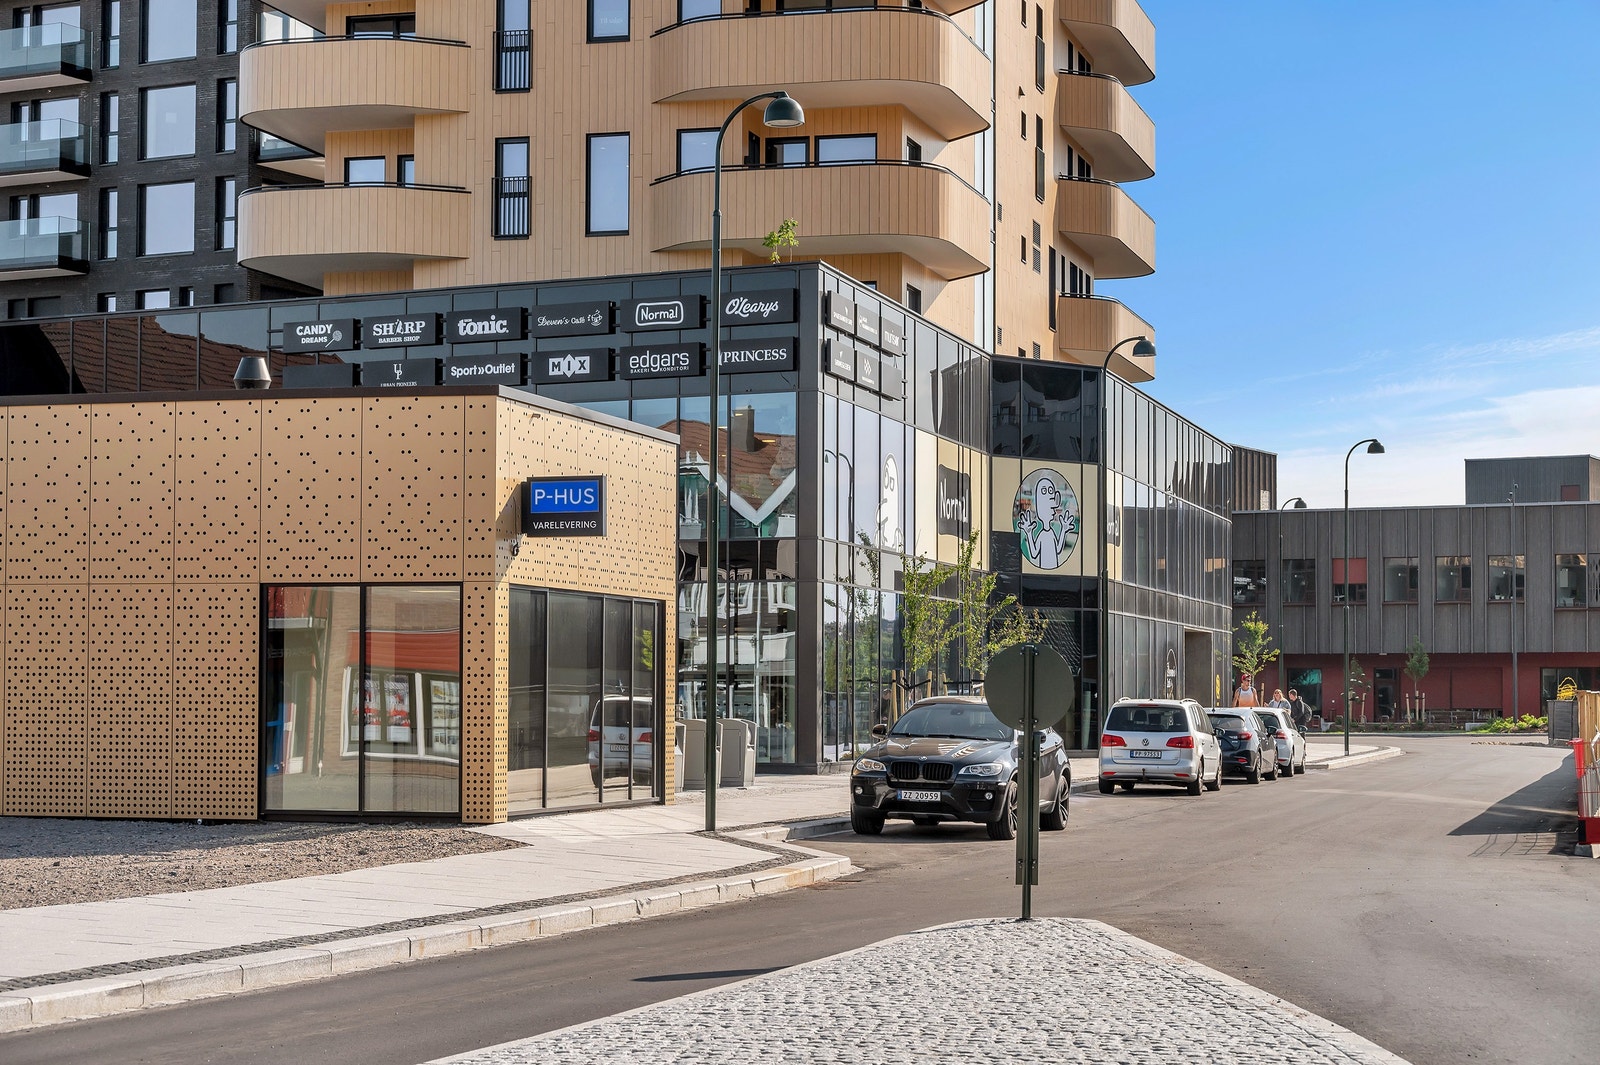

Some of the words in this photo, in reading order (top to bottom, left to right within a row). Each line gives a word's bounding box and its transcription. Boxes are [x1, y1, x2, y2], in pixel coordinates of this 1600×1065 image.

[640, 306, 679, 323] Normal
[725, 296, 779, 318] O'Learys
[296, 323, 333, 336] CANDY
[372, 318, 426, 337] SHARP
[301, 335, 328, 344] DREAMS
[378, 336, 402, 344] BARBER
[403, 335, 421, 343] SHOP
[629, 350, 690, 373] edgars
[722, 348, 787, 364] PRINCESS
[551, 358, 587, 373] MIX
[659, 365, 690, 373] KONDITORI
[534, 488, 594, 504] P-HUS
[533, 520, 597, 529] VARELEVERING
[903, 791, 913, 800] ZZ
[915, 791, 939, 801] 20959
